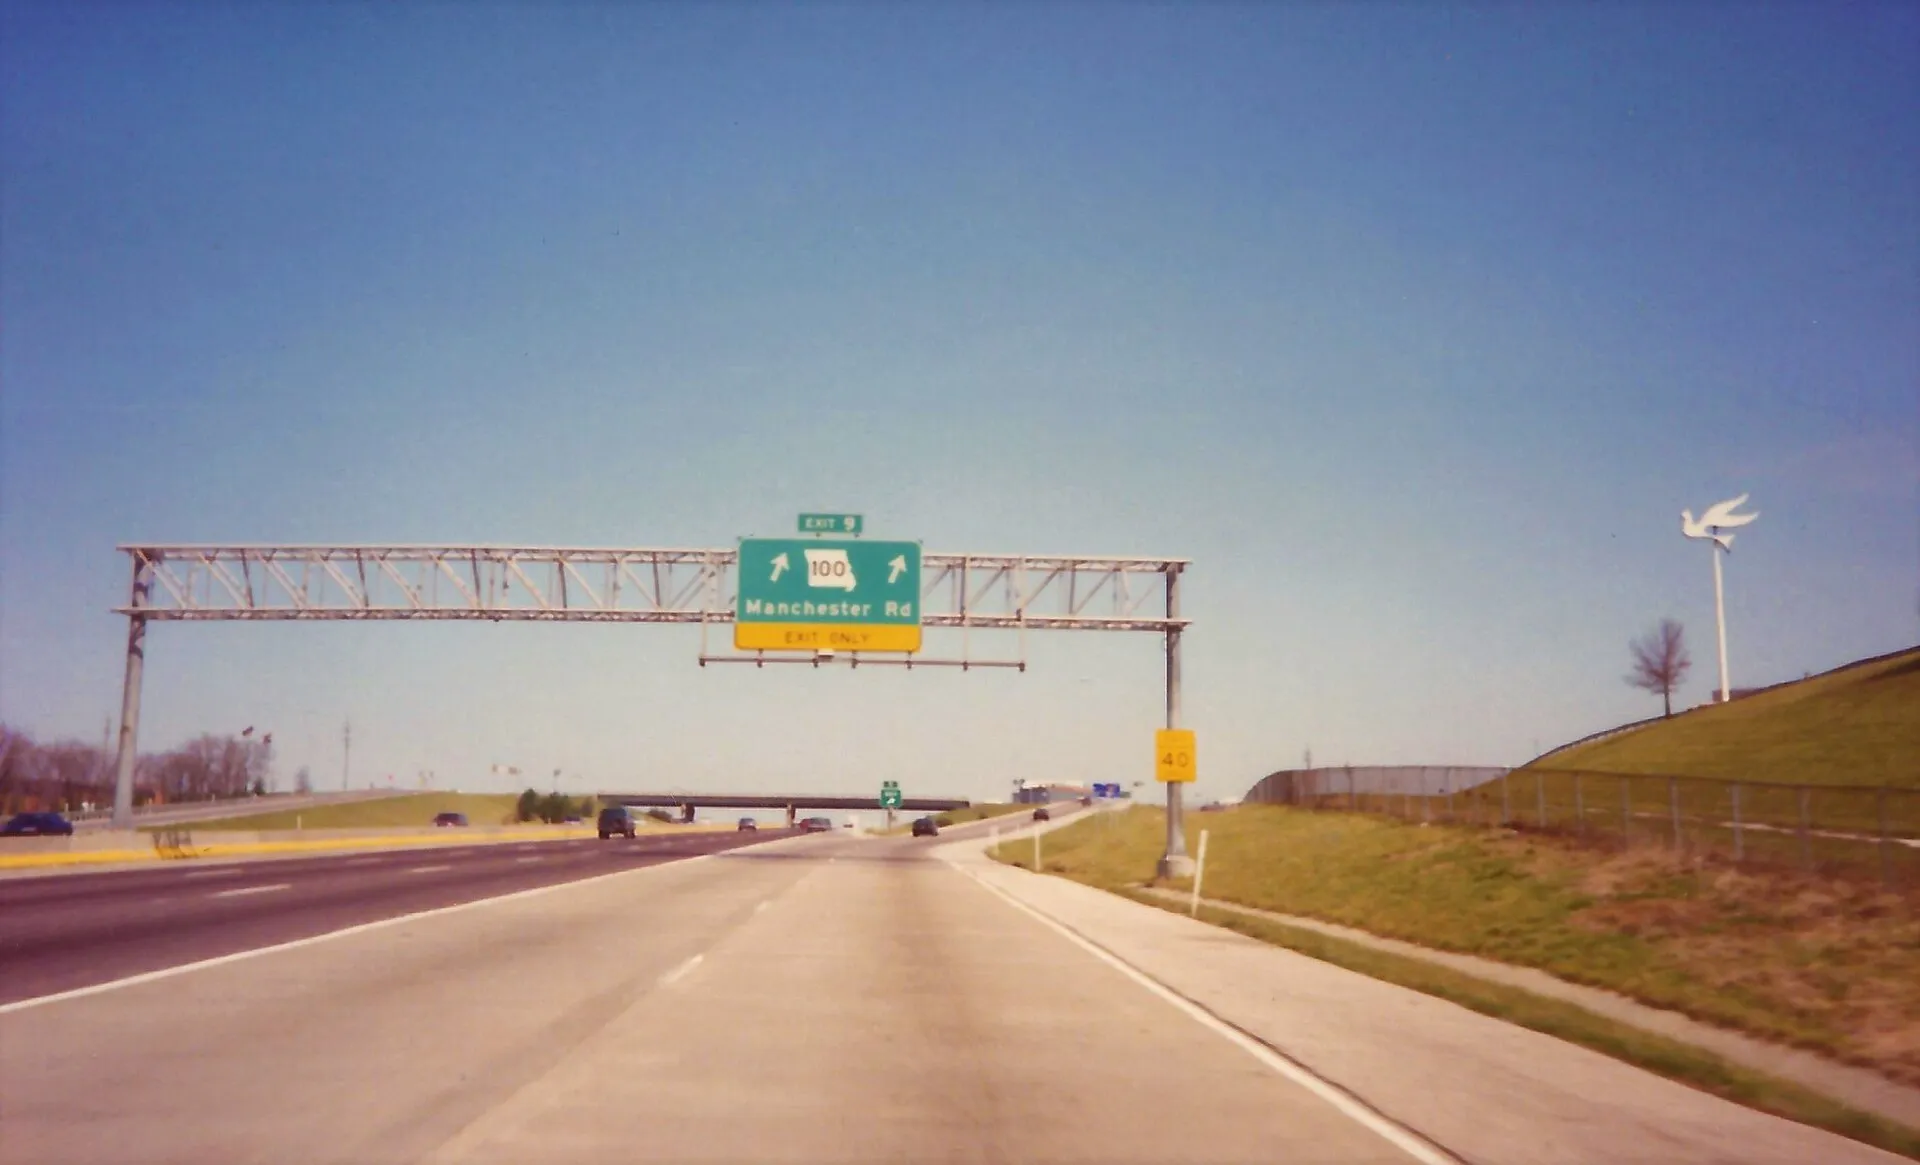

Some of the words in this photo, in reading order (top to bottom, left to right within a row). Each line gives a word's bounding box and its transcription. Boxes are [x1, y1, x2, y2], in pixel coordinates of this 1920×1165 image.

[805, 518, 835, 529] EXIT
[844, 516, 855, 532] 9
[811, 560, 846, 577] 100
[745, 599, 872, 616] Manchester
[884, 601, 912, 617] Rd
[785, 631, 818, 644] EXIT
[829, 632, 871, 644] ONLY
[1161, 752, 1189, 768] 40
